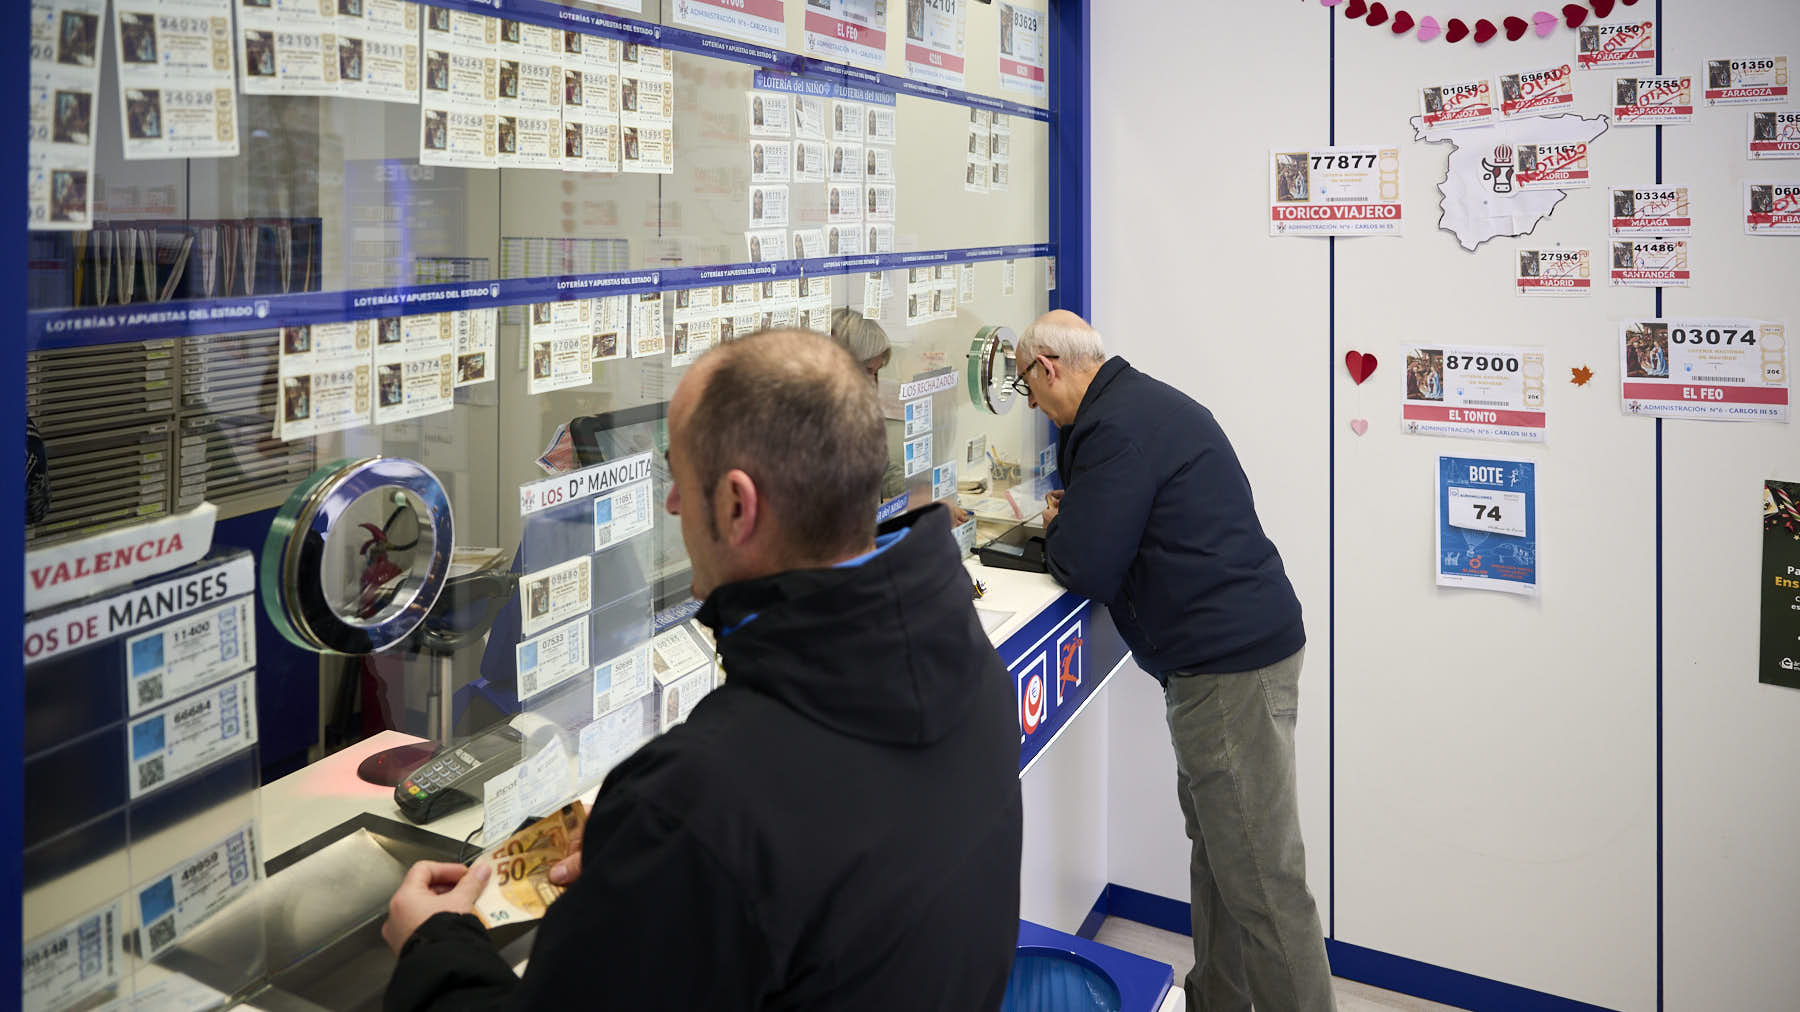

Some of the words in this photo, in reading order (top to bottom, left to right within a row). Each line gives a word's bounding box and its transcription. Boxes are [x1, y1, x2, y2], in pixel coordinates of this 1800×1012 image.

[560, 11, 590, 25] LOTERÍAS
[595, 18, 622, 30] APUESTAS
[634, 26, 653, 36] ESTADO
[1014, 12, 1037, 31] 83629
[1601, 24, 1640, 34] 27450
[838, 23, 845, 36] EL
[846, 26, 858, 40] FEO
[702, 39, 725, 50] LOTERÍAS
[1732, 60, 1774, 70] 01350
[764, 76, 791, 90] LOTERÍA
[794, 81, 804, 92] del
[806, 82, 824, 94] NIÑO
[1443, 84, 1478, 96] 01058
[1638, 80, 1678, 88] 77555
[840, 86, 862, 98] LOTERÍA
[864, 90, 874, 100] del
[874, 90, 890, 103] NIÑO
[1721, 88, 1772, 98] ZARAGOZA
[1311, 154, 1377, 170] 77877
[1635, 191, 1675, 200] 03344
[1277, 206, 1330, 219] TORICO
[1332, 206, 1396, 218] VIAJERO
[700, 270, 724, 278] LOTERÍAS
[1622, 271, 1676, 279] SANTANDER
[558, 280, 588, 289] LOTERÍAS
[593, 278, 620, 286] APUESTAS
[1540, 279, 1574, 287] MADRID
[354, 294, 400, 308] LOTERÍAS
[406, 292, 446, 303] APUESTAS
[446, 290, 460, 298] DEL
[461, 288, 489, 298] ESTADO
[46, 315, 116, 332] LOTERÍAS
[127, 312, 186, 326] APUESTAS
[189, 310, 208, 320] DEL
[210, 306, 254, 319] ESTADO
[1672, 328, 1756, 346] 03074
[1447, 356, 1518, 372] 87900
[902, 382, 917, 398] LOS
[1683, 387, 1697, 399] EL
[1701, 388, 1724, 400] FEO
[1644, 404, 1706, 412] ADMINISTRACIÓN
[1449, 410, 1461, 420] EL
[1464, 410, 1496, 423] TONTO
[1420, 425, 1475, 434] ADMINISTRACIÓN
[542, 486, 562, 507] LOS
[588, 458, 652, 493] MANOLITA
[1469, 466, 1504, 484] BOTE
[1472, 504, 1502, 522] 74
[31, 533, 184, 590] VALENCIA
[1775, 576, 1800, 588] Ens
[66, 616, 98, 646] DE
[110, 572, 229, 632] MANISES
[174, 620, 210, 642] 11400
[497, 858, 526, 886] 50
